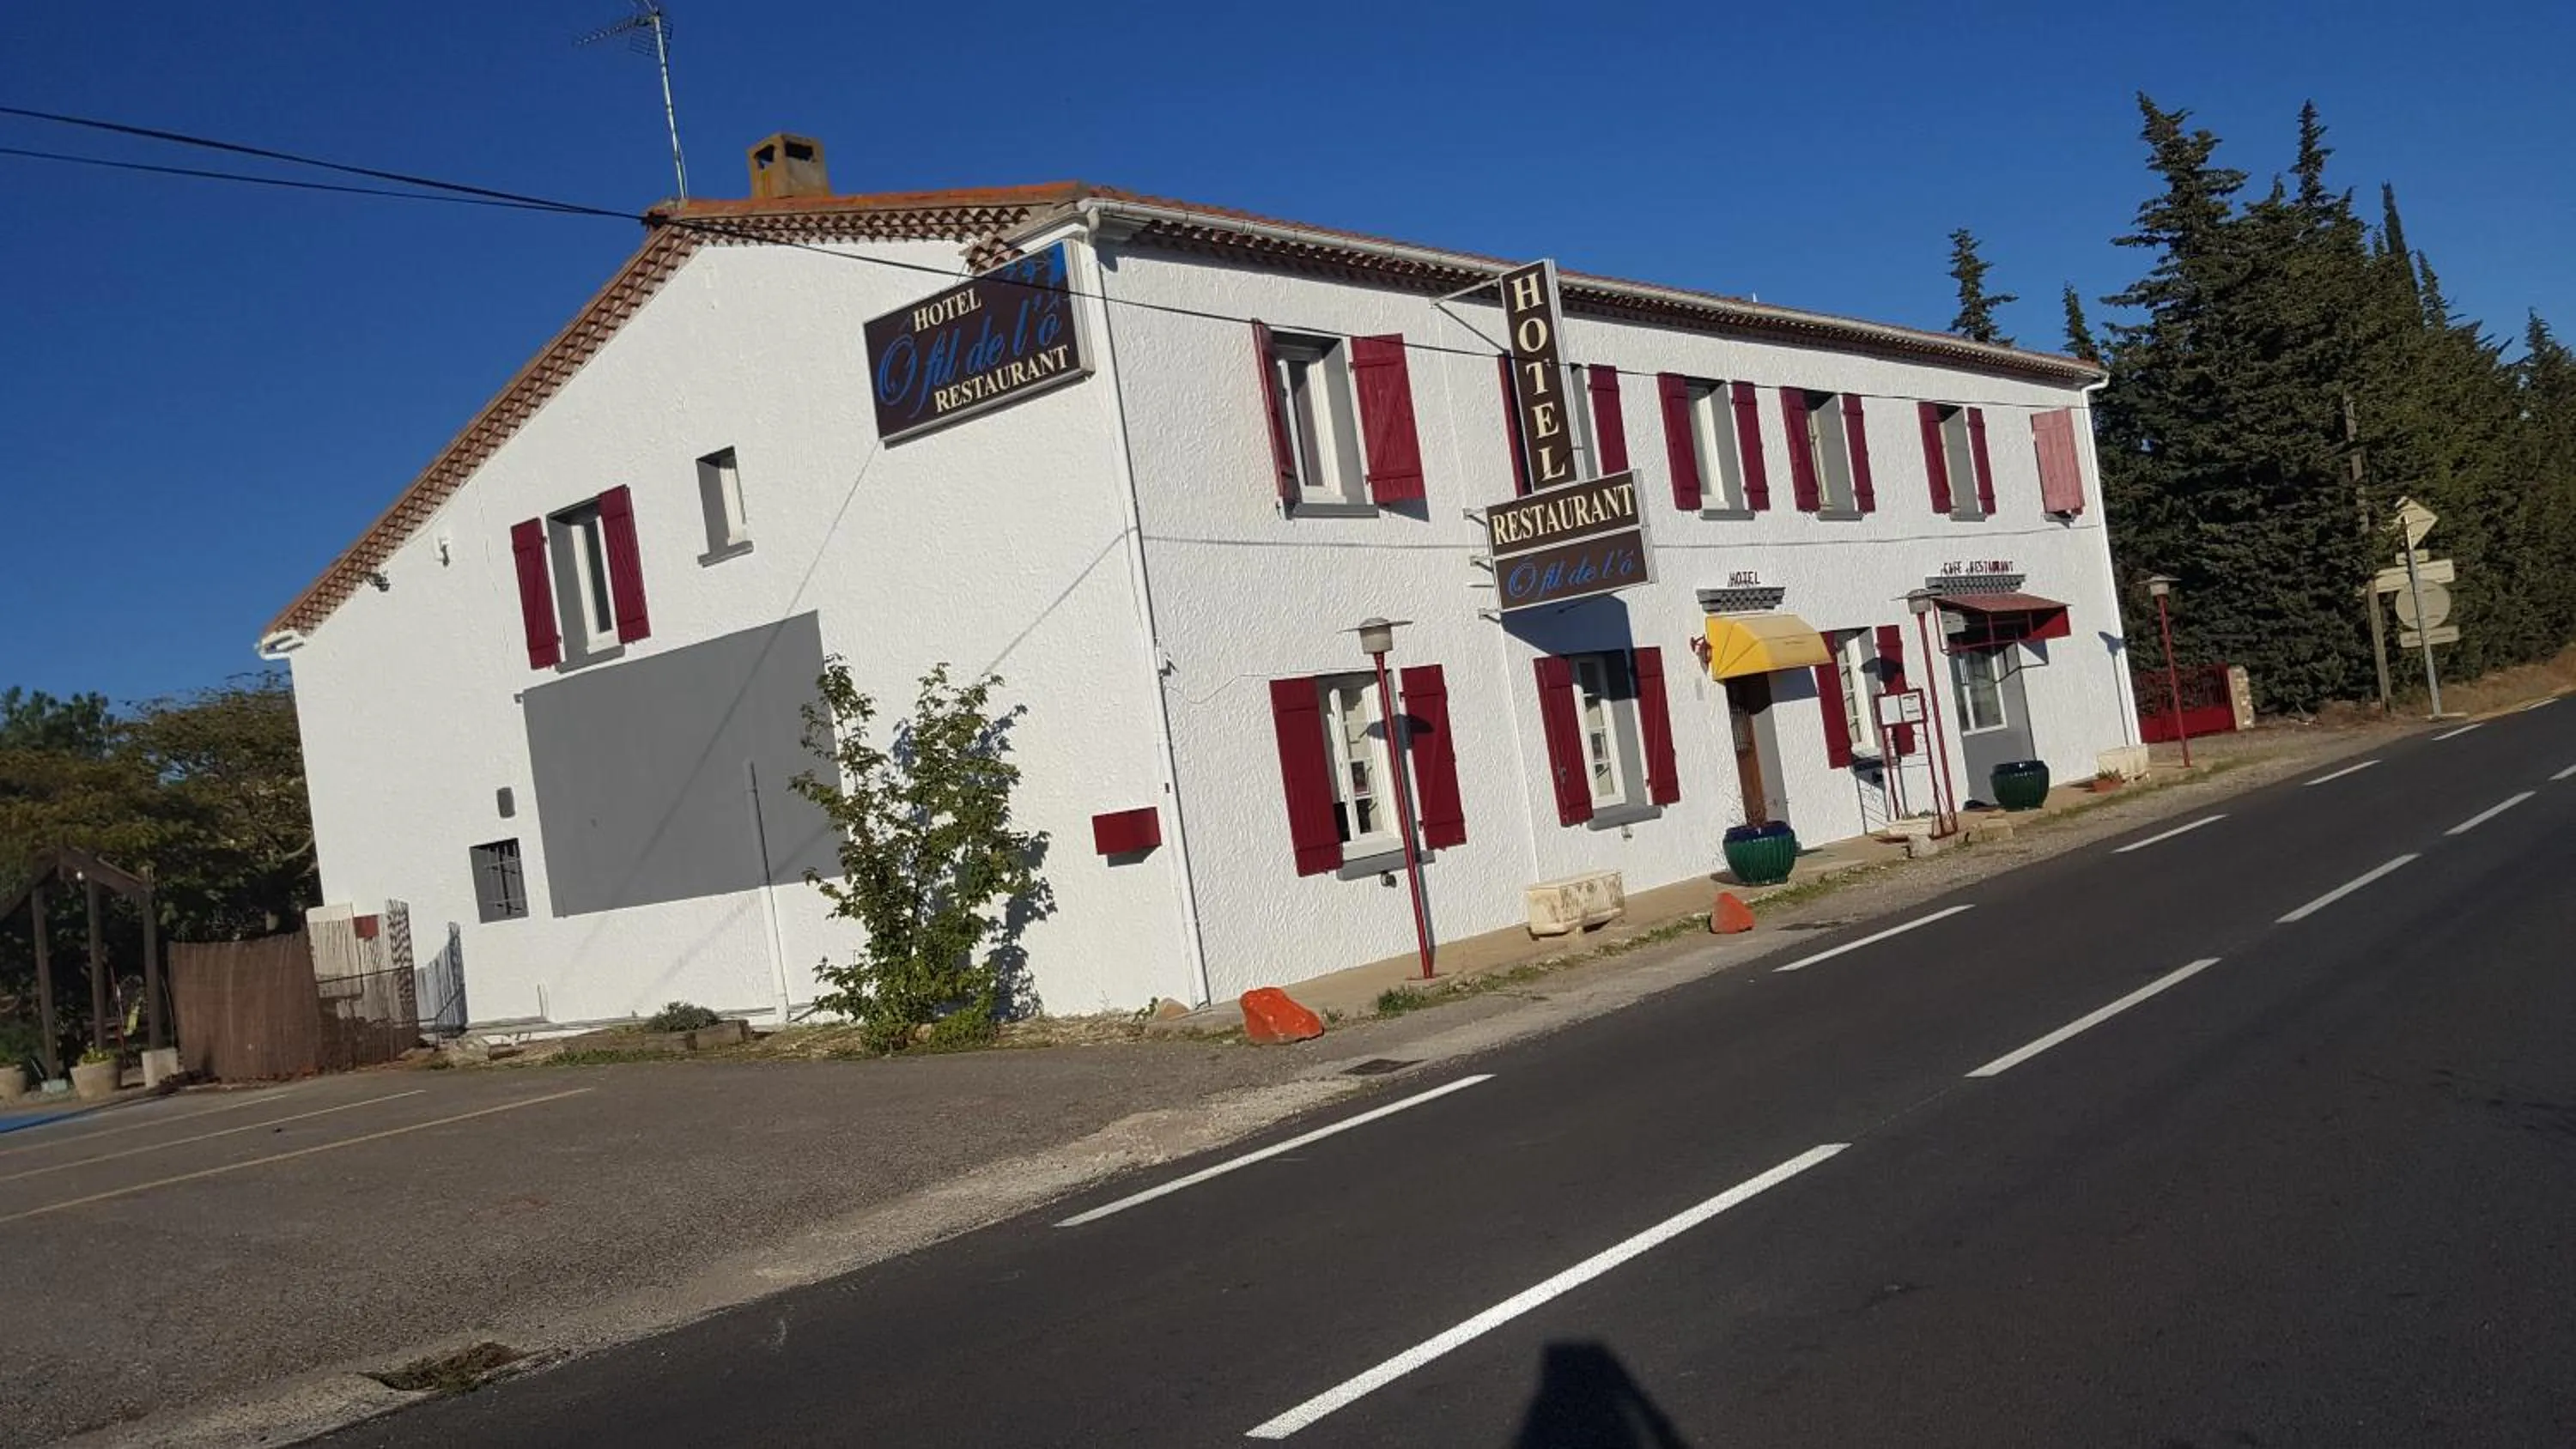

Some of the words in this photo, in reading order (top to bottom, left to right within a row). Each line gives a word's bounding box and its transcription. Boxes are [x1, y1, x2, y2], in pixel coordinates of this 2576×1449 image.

[913, 288, 981, 332] HOTEL
[908, 326, 961, 419] fil
[966, 314, 1005, 375] de
[933, 344, 1069, 413] RESTAURANT
[1511, 272, 1566, 482] HOTEL
[1492, 483, 1634, 545] RESTAURANT
[1568, 553, 1597, 585] de
[1728, 571, 1761, 587] HOTEL
